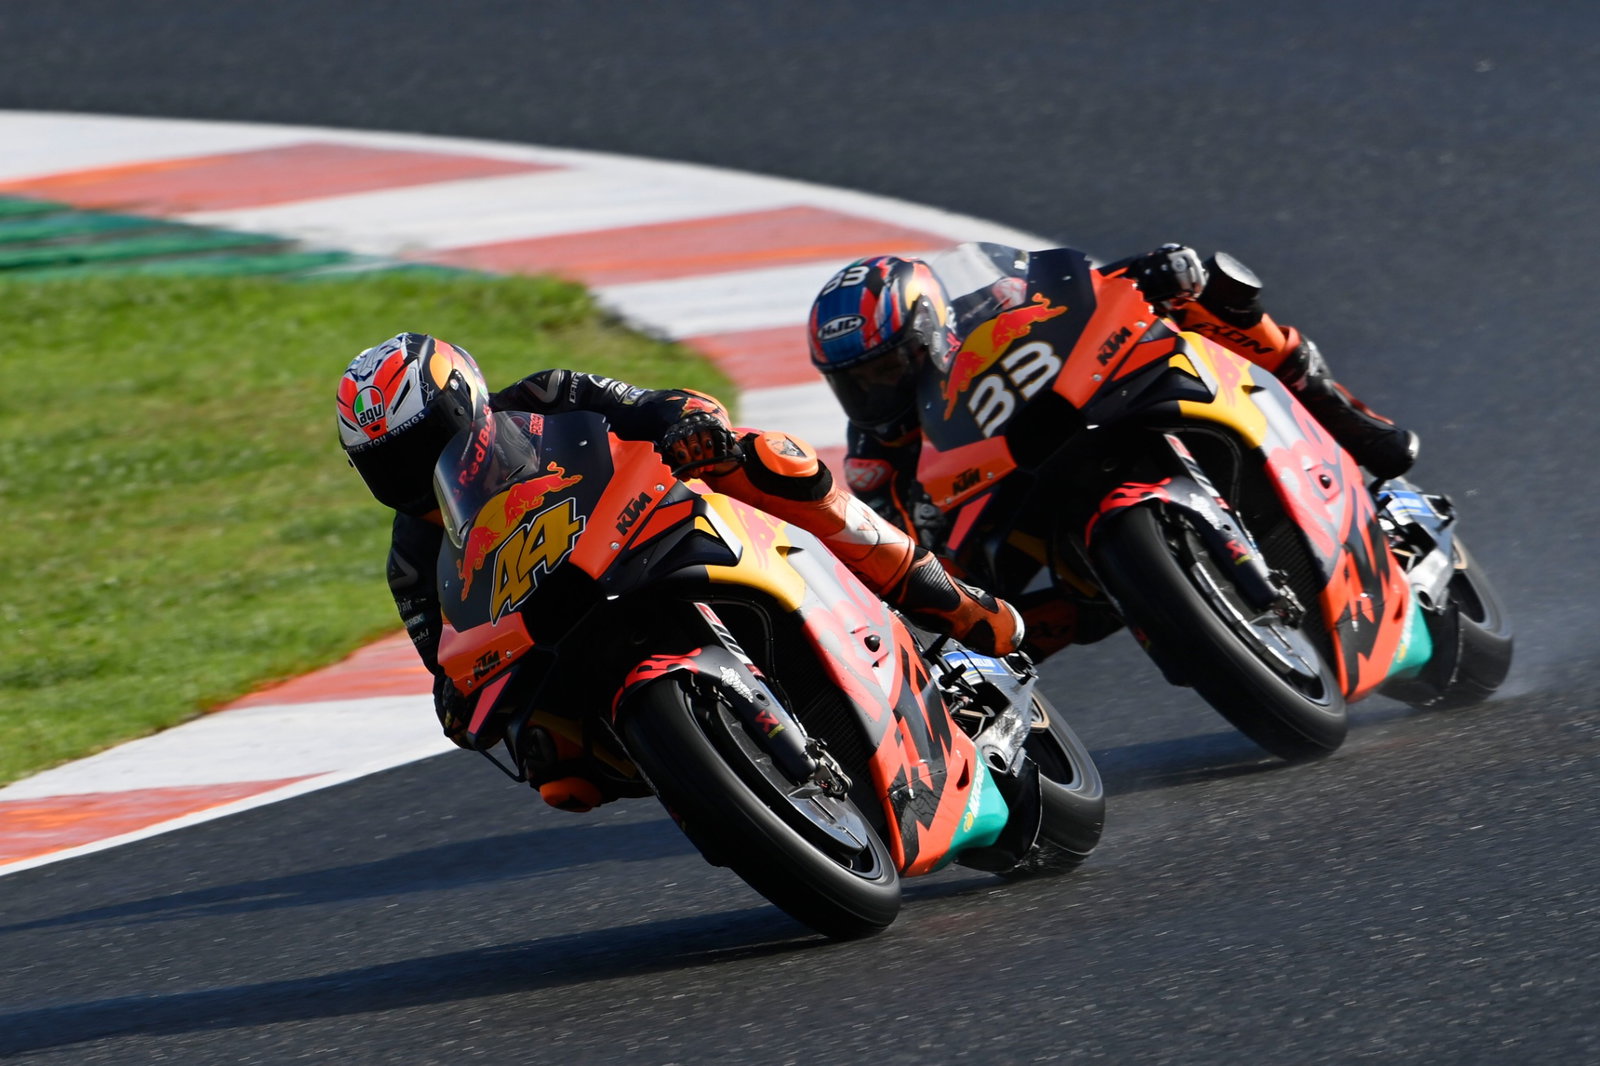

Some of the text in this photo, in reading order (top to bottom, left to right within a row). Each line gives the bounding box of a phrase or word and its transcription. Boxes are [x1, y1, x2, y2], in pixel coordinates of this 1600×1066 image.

[821, 317, 859, 337] HJC
[1096, 326, 1134, 367] KTM
[967, 340, 1063, 439] 33
[391, 412, 425, 437] WINGS
[952, 468, 981, 497] KTM
[616, 491, 653, 536] KTM
[489, 497, 586, 628] 44
[472, 650, 502, 682] KTM
